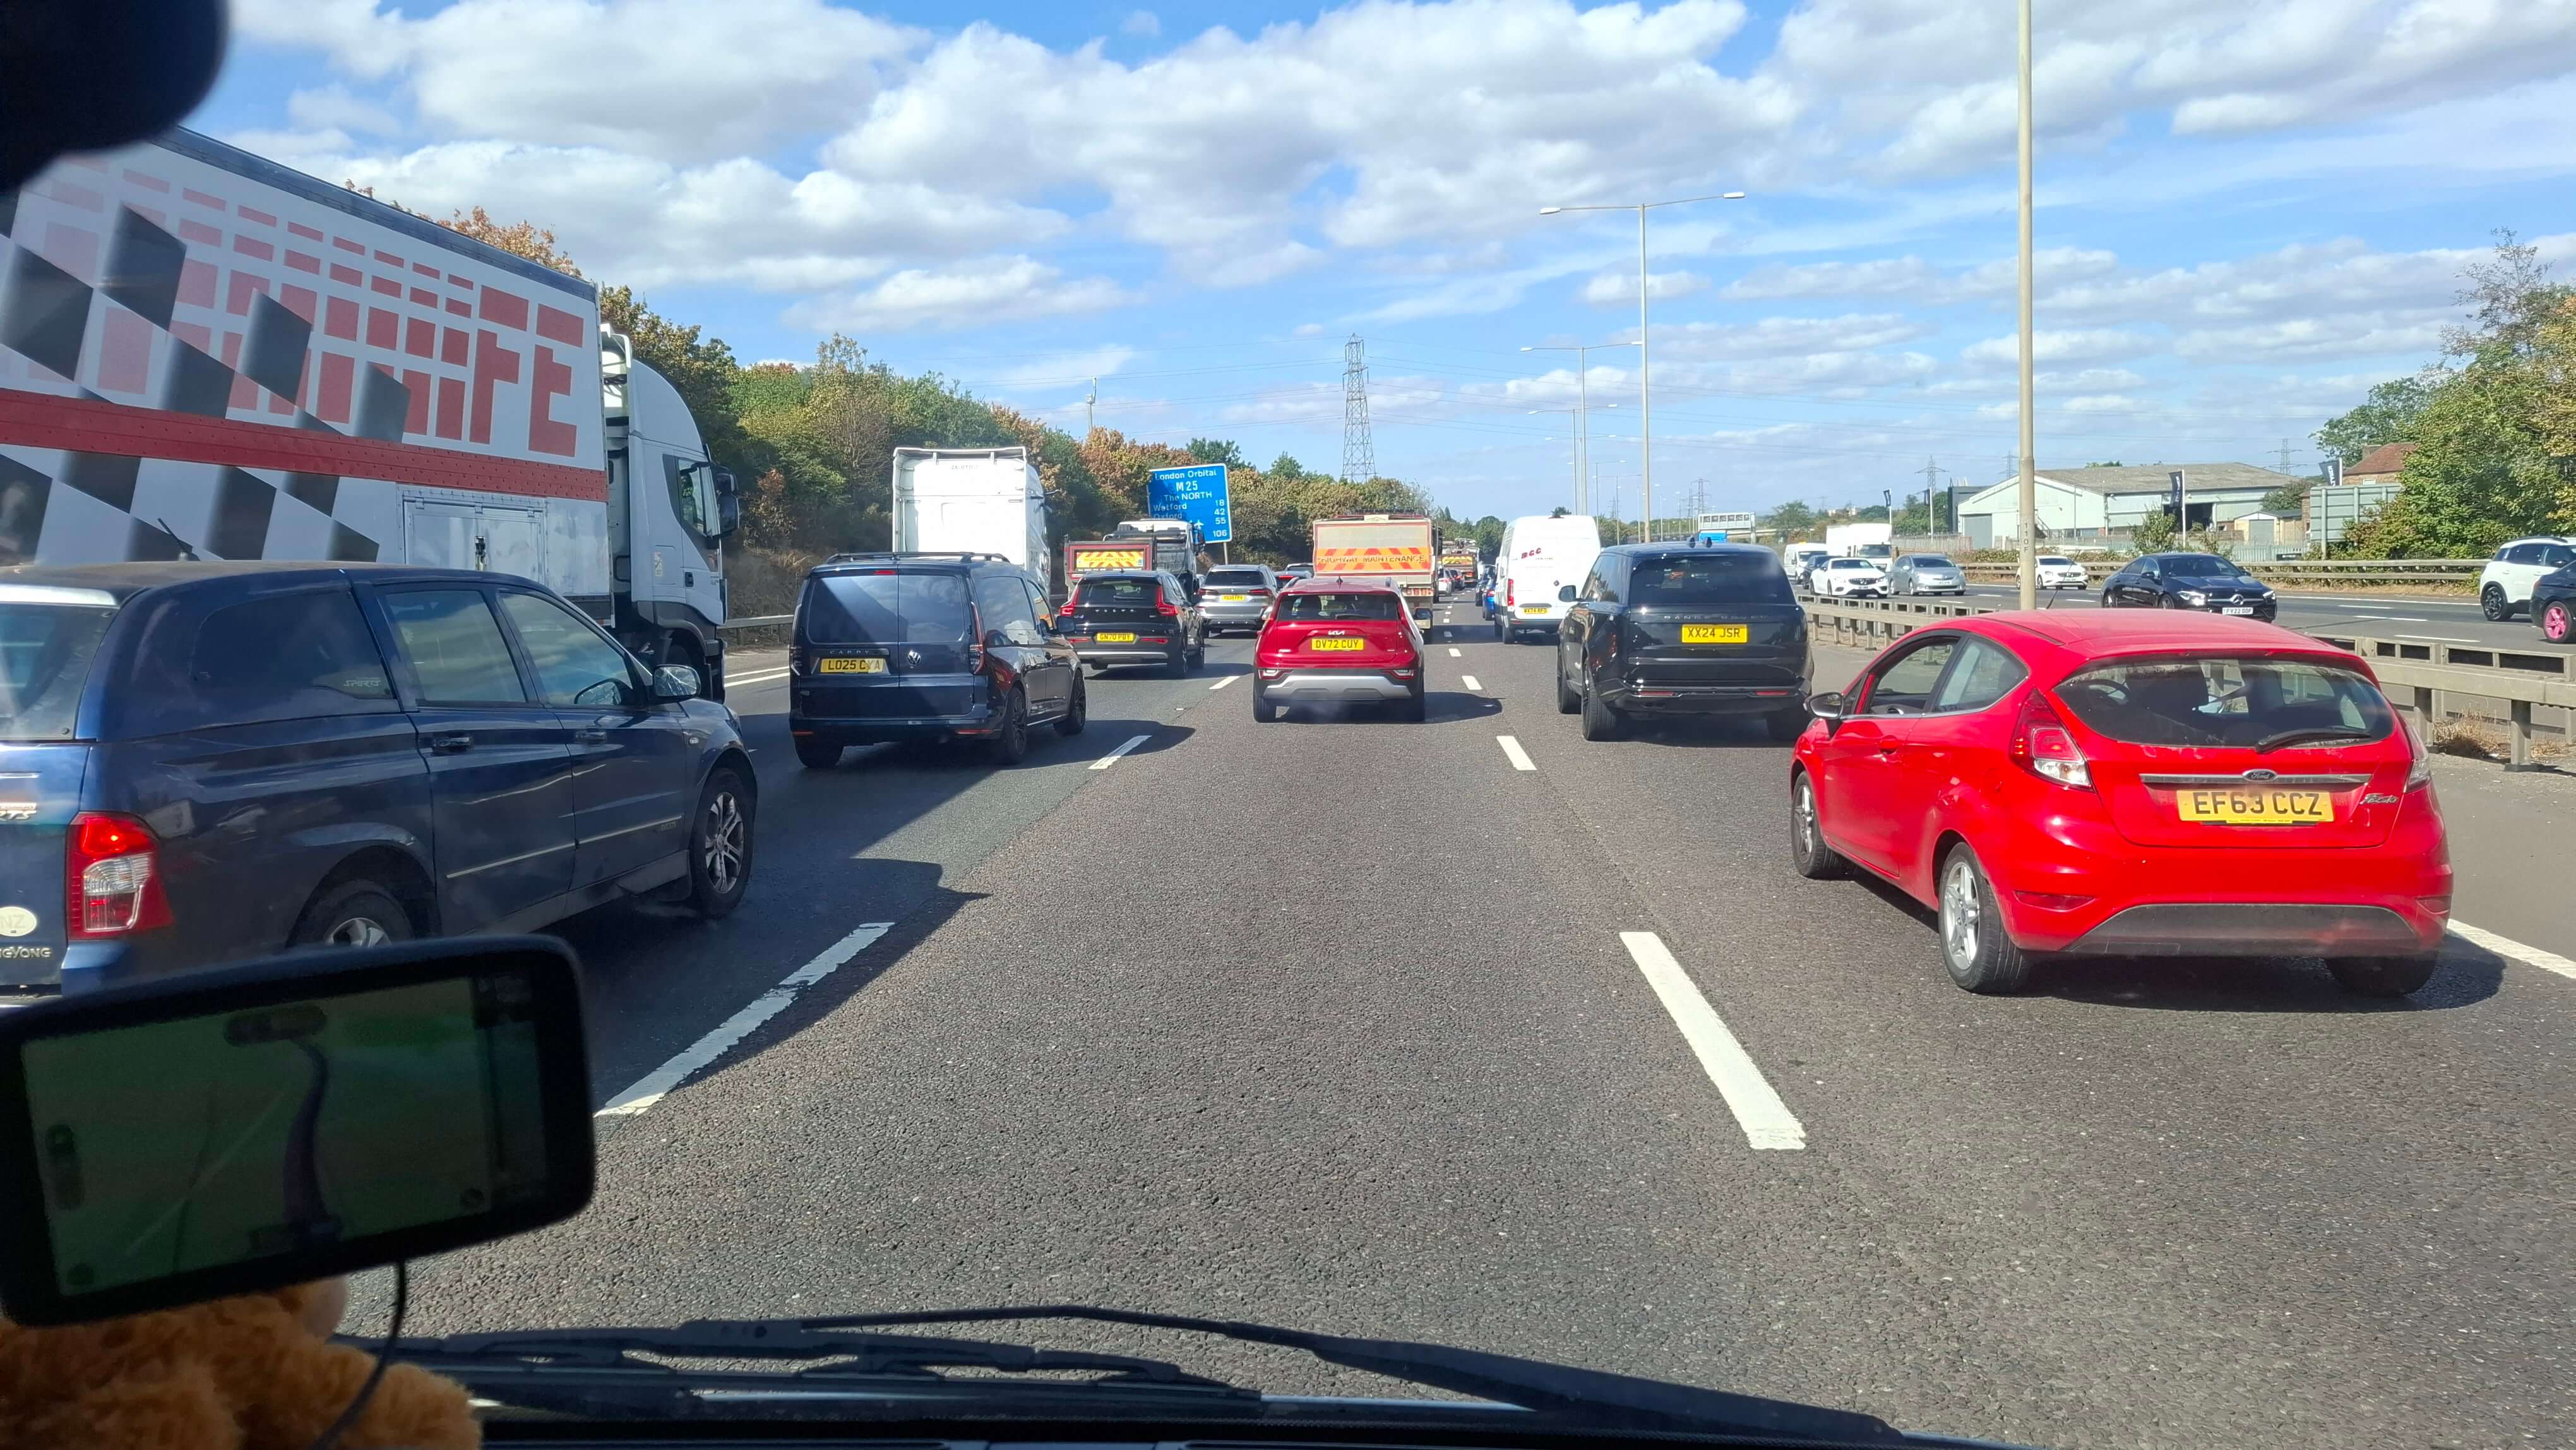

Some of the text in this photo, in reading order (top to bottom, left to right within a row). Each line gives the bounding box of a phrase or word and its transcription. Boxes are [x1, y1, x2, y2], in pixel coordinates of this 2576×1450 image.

[1155, 469, 1217, 480] London Orbital
[1181, 491, 1212, 500] NORTH
[1153, 502, 1187, 511] Watford
[1215, 517, 1227, 525] 55
[1212, 529, 1227, 537] 106
[1363, 554, 1426, 563] MAINTENANCE
[1687, 628, 1740, 638] XX24 JSR
[1315, 639, 1359, 649] DV72 CUY
[859, 659, 880, 671] CYA
[2251, 771, 2270, 780] Ford
[2192, 791, 2323, 816] EF63 CCZ
